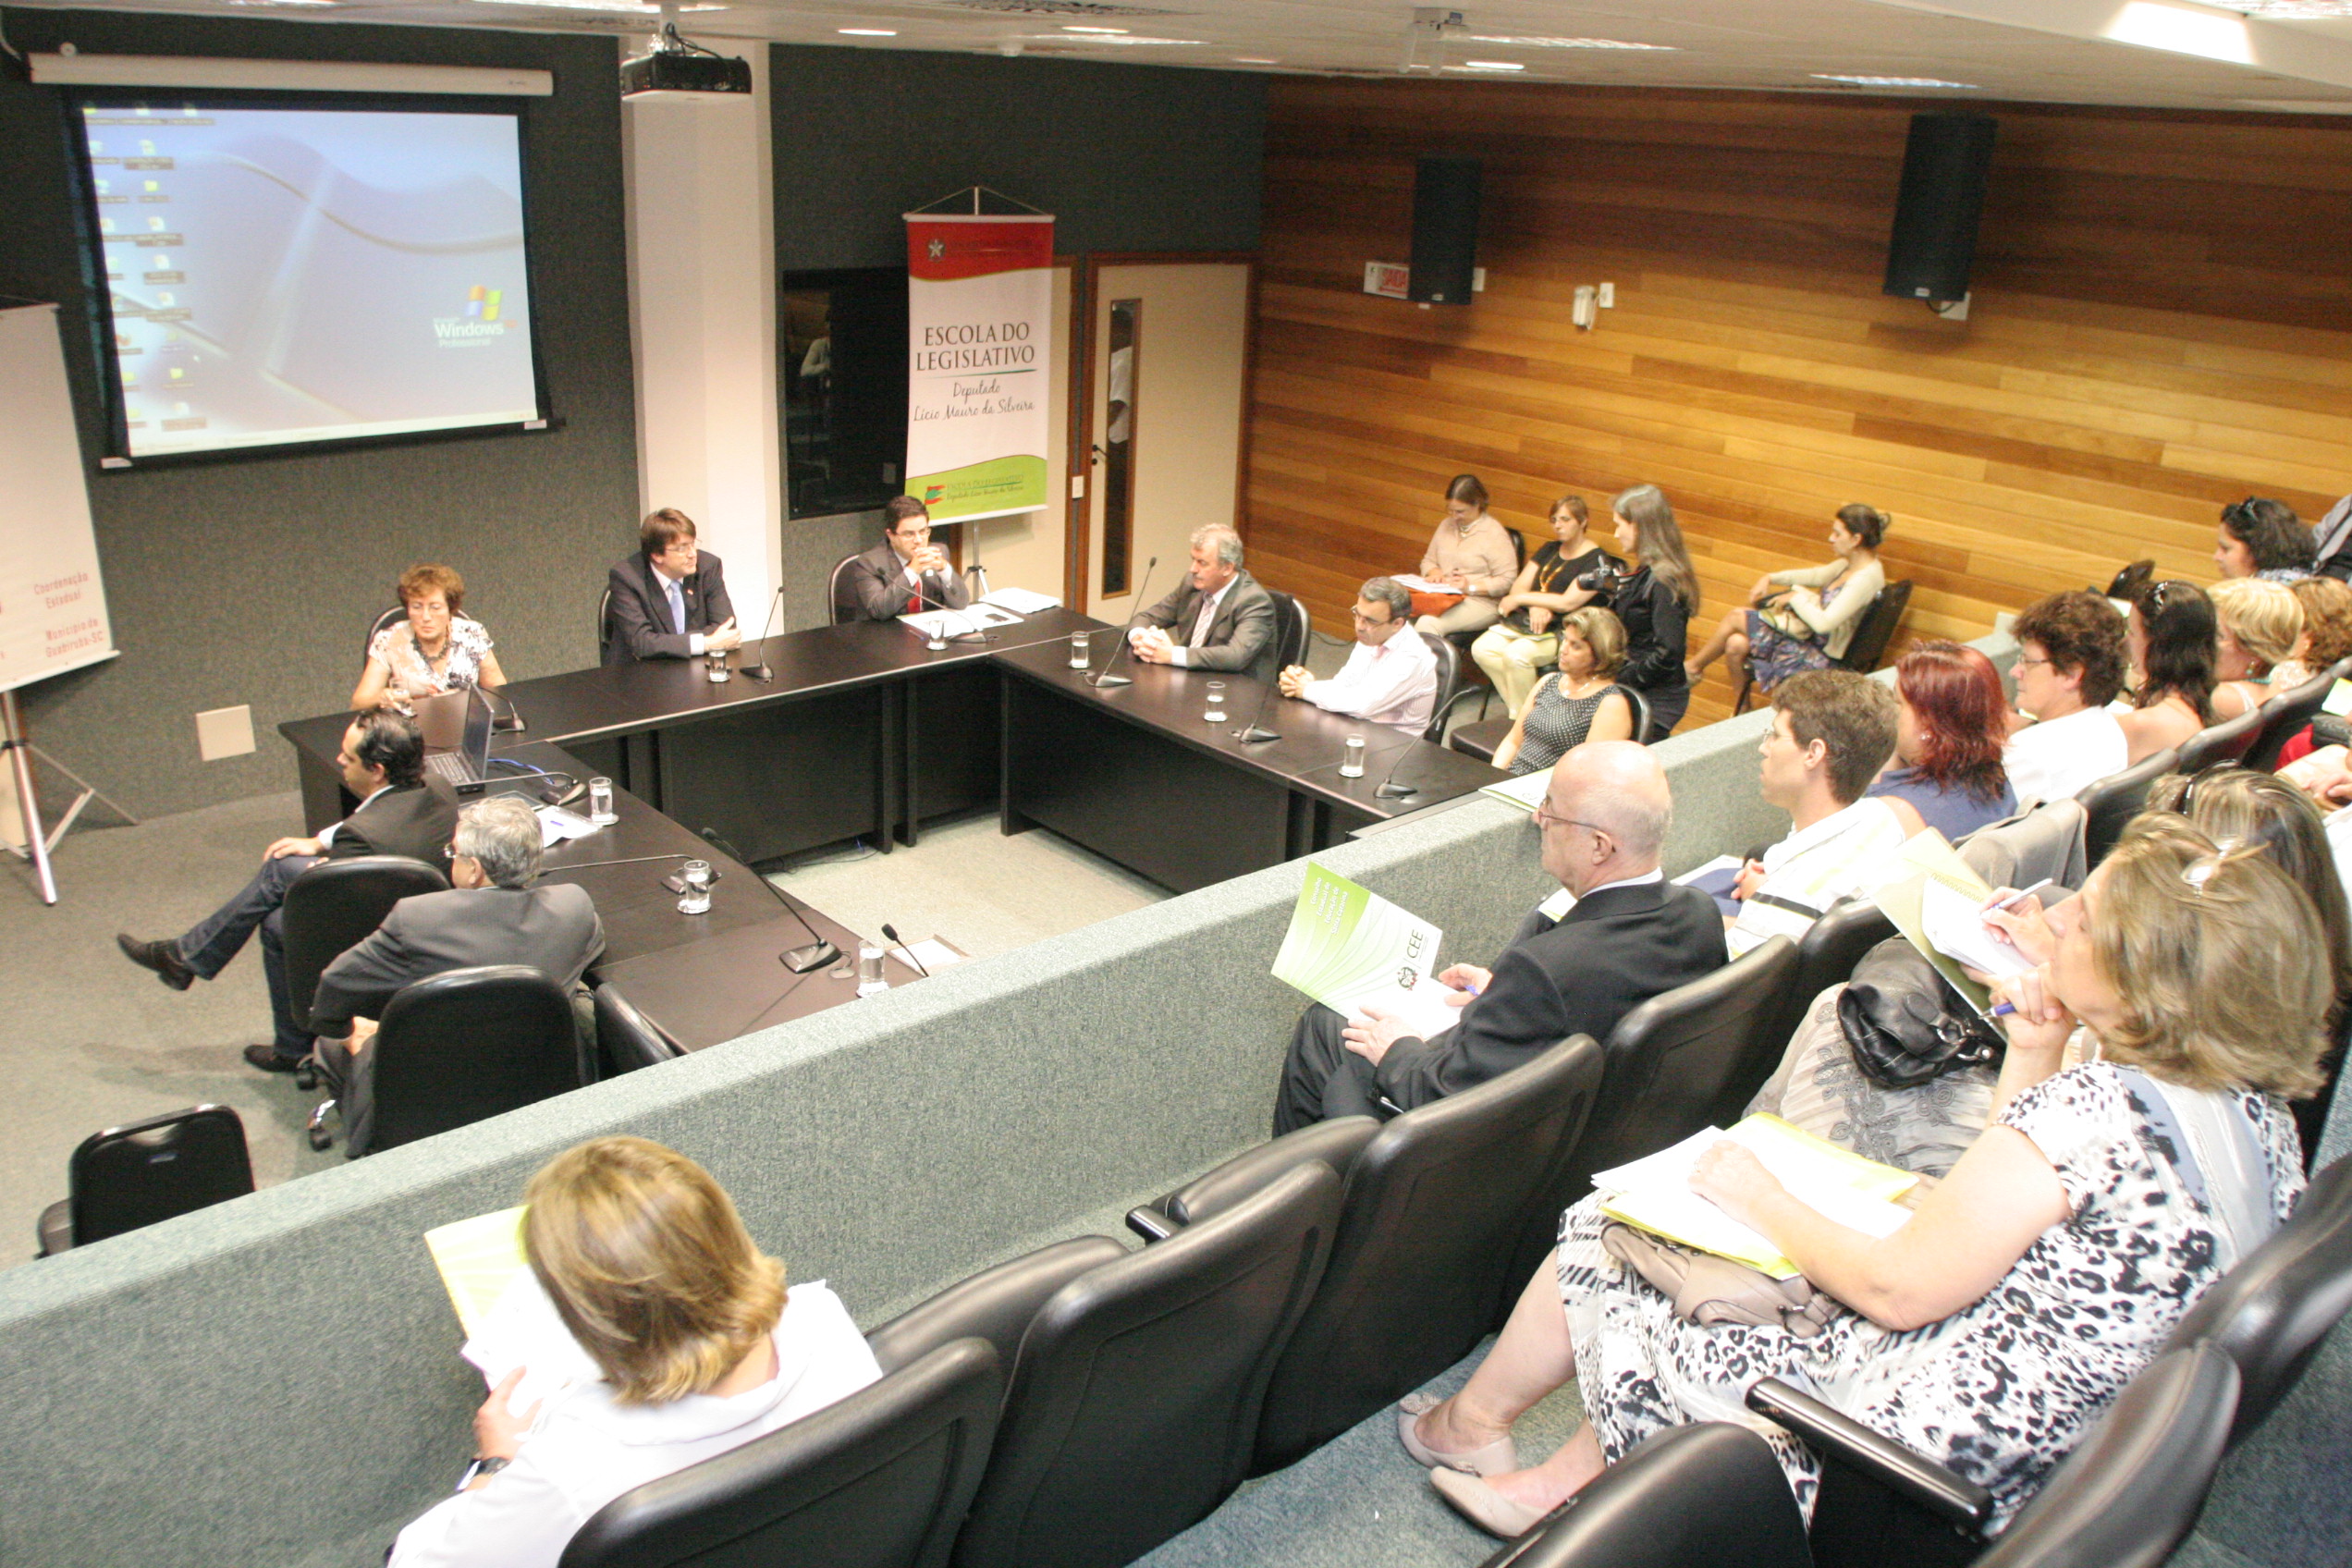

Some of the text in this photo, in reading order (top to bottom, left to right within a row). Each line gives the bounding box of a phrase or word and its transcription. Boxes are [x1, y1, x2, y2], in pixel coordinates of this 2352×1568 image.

[435, 321, 504, 337] Windows
[925, 322, 1030, 346] ESCOLA DO
[916, 345, 1035, 372] LEGISLATIVO
[953, 378, 1000, 405] Deputado
[943, 404, 978, 420] Mauro
[981, 399, 995, 414] da
[997, 396, 1035, 414] Silveira
[1406, 928, 1424, 959] CEE
